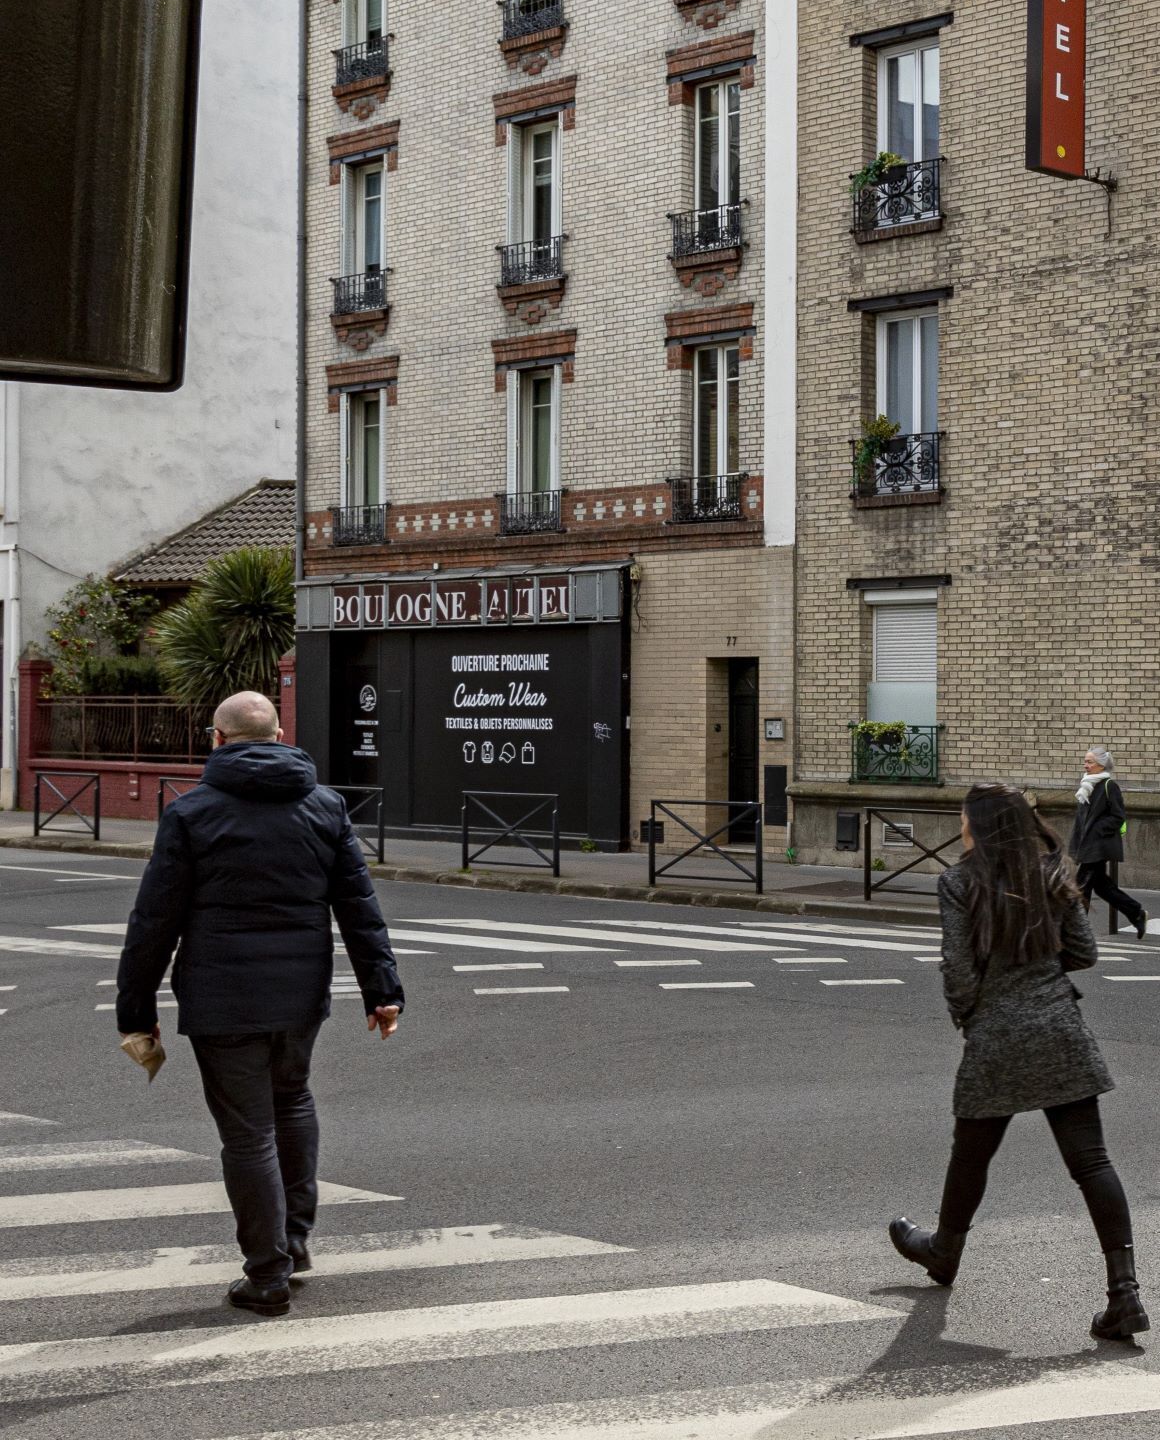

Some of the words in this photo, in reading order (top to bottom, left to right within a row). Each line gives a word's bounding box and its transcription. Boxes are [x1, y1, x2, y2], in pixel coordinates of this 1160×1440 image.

[333, 591, 466, 623] BOULOGNE
[726, 636, 737, 647] 77
[451, 655, 500, 672] OUVERTURE
[501, 653, 549, 671] PROCHAINE
[454, 683, 506, 708] Custom
[508, 682, 547, 706] Wear
[445, 717, 473, 729] TEXTILES
[473, 717, 479, 729] &
[480, 718, 502, 729] OBJETS
[503, 718, 553, 730] PERSONNALISES
